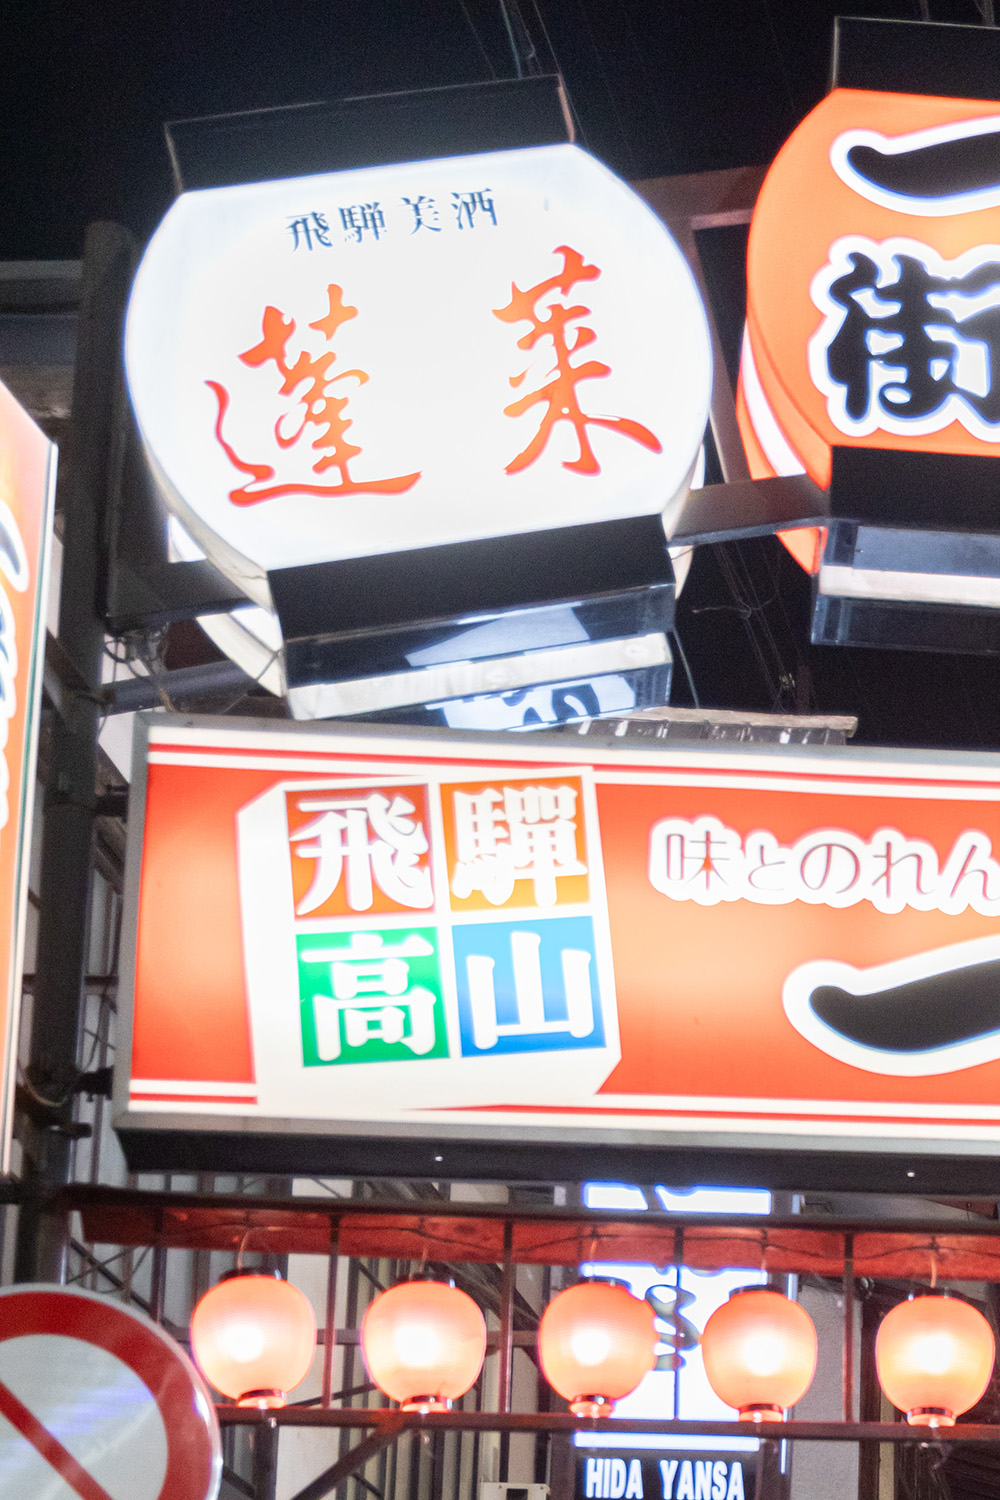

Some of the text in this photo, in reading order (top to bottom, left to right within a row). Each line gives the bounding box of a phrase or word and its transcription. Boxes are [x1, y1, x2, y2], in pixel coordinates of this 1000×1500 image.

[285, 187, 499, 252] 飛騨美酒
[300, 930, 595, 1062] 高山
[585, 1457, 644, 1500] HIDA
